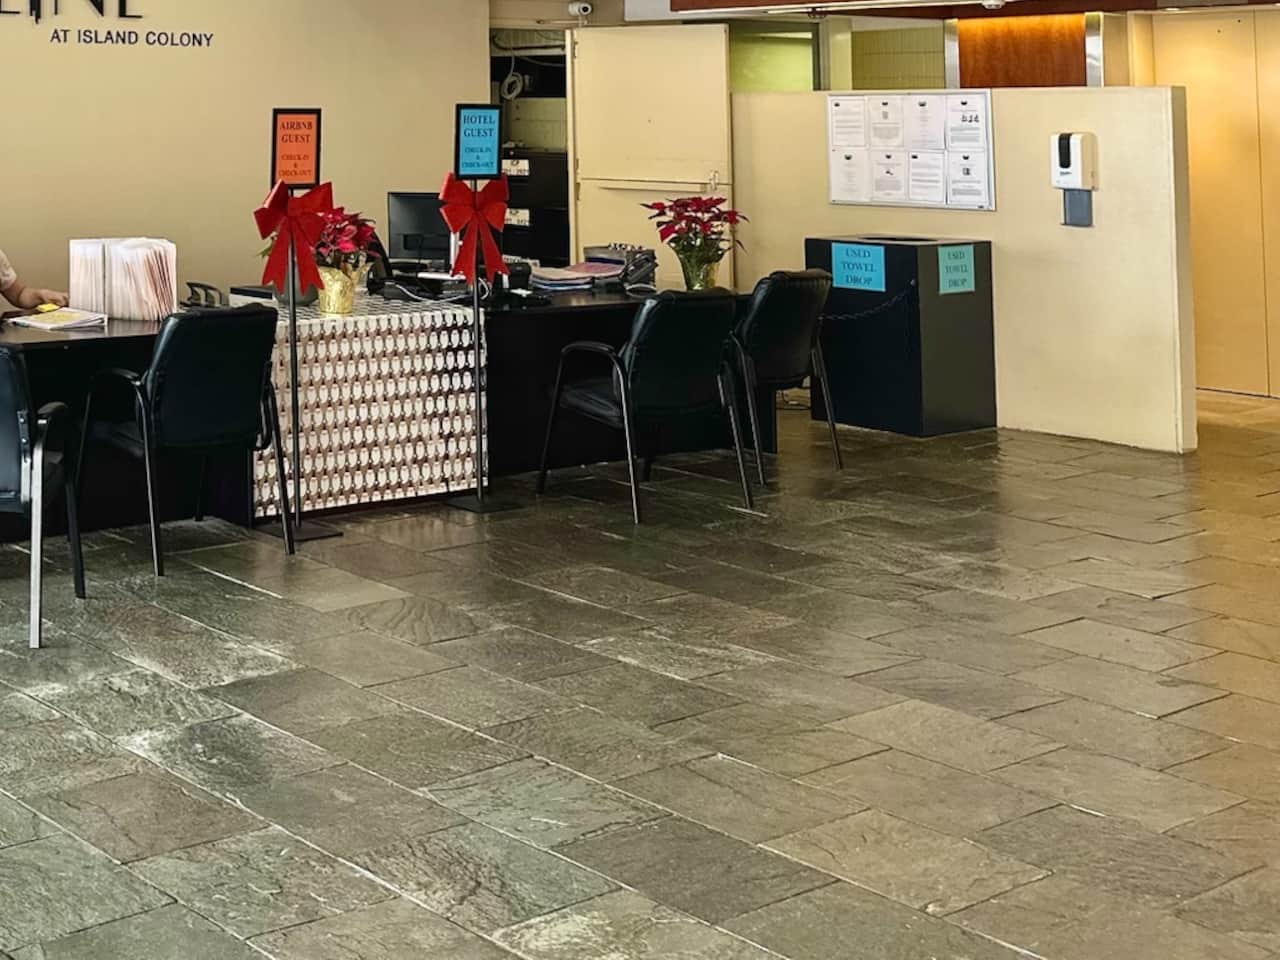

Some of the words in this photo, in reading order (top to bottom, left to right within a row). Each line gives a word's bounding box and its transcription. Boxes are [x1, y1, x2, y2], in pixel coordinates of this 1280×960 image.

[50, 28, 70, 44] AT
[77, 29, 139, 45] ISLAND
[145, 31, 214, 47] COLONY
[463, 114, 496, 125] HOTEL
[280, 121, 313, 130] AIRBNB
[464, 127, 495, 138] GUEST
[281, 134, 312, 144] GUEST
[845, 246, 872, 258] USED
[841, 261, 877, 272] TOWEL
[845, 274, 872, 286] DROP
